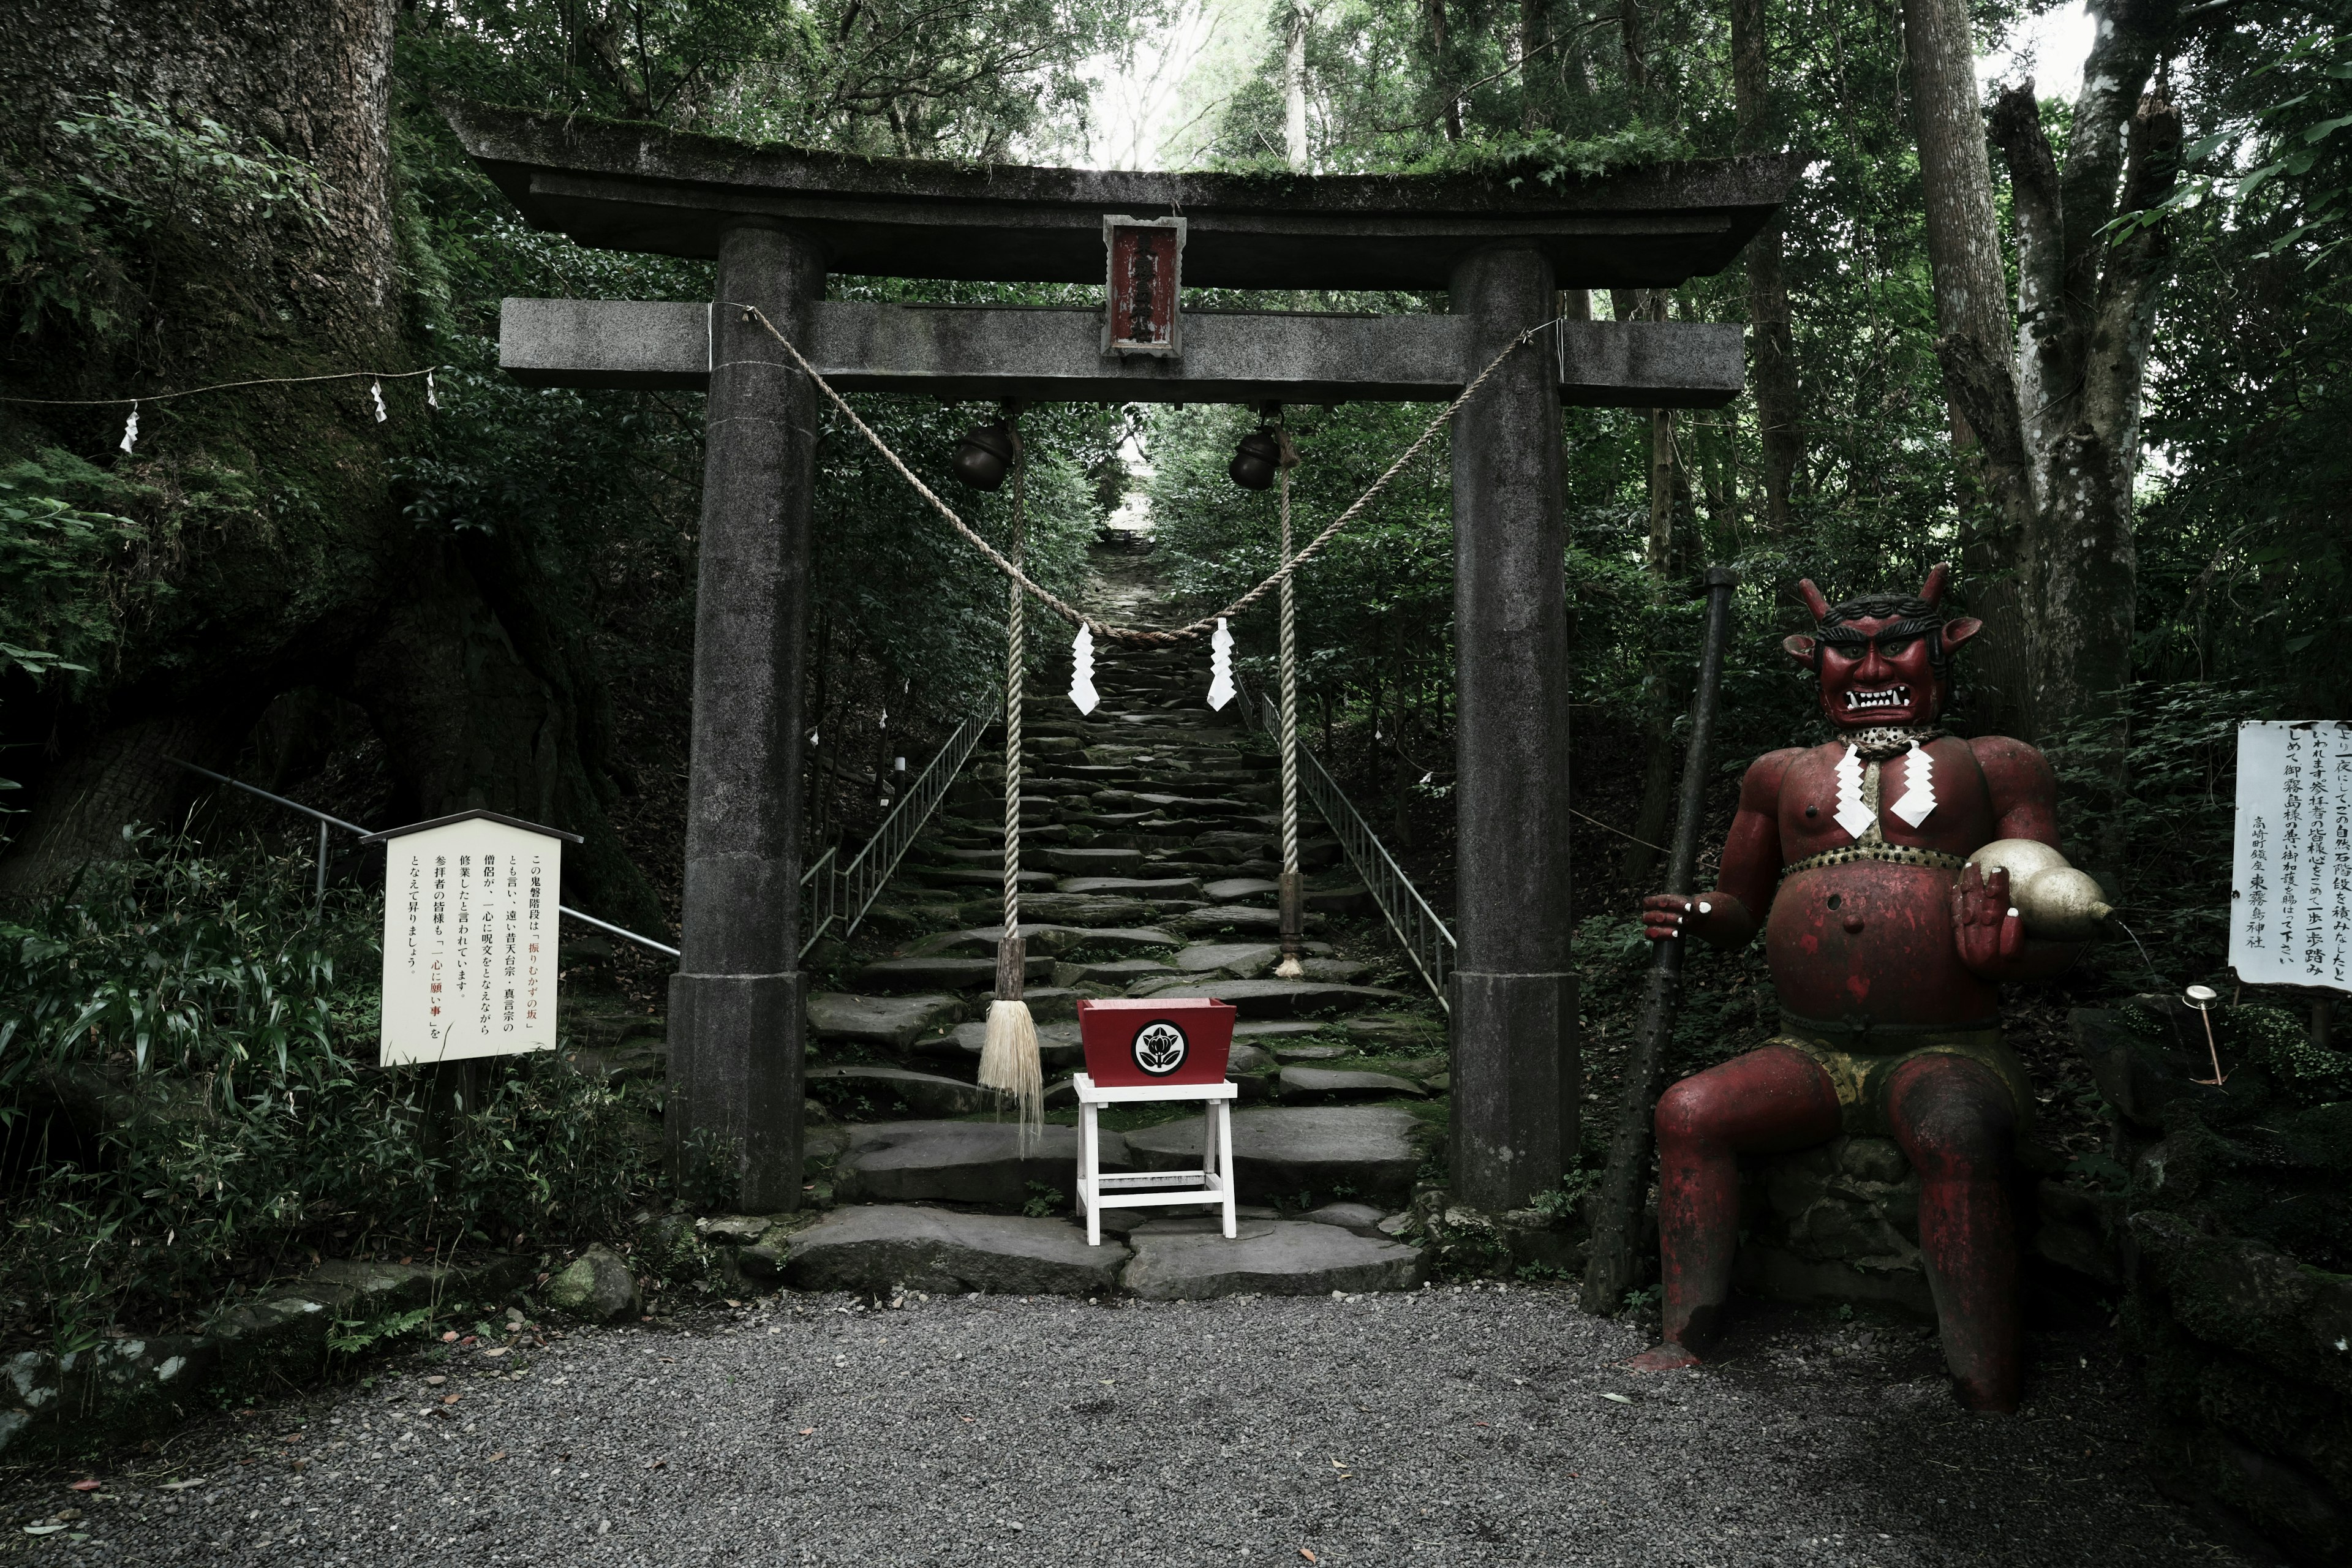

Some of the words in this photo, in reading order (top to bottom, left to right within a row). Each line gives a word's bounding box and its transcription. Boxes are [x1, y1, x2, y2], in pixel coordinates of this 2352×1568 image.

[407, 856, 420, 974] となえて昇りましょう。
[429, 855, 447, 1039] 参拝者の皆様も「一心に願い事」を
[456, 855, 471, 998] 修業したと言われています。
[480, 854, 496, 1035] 僧侶が、一心に呪文をとなえながら
[503, 855, 518, 1033] とも言い、遠い昔天台宗・真言宗の
[526, 855, 541, 1029] この鬼磐階段は「振りむかずの坂」
